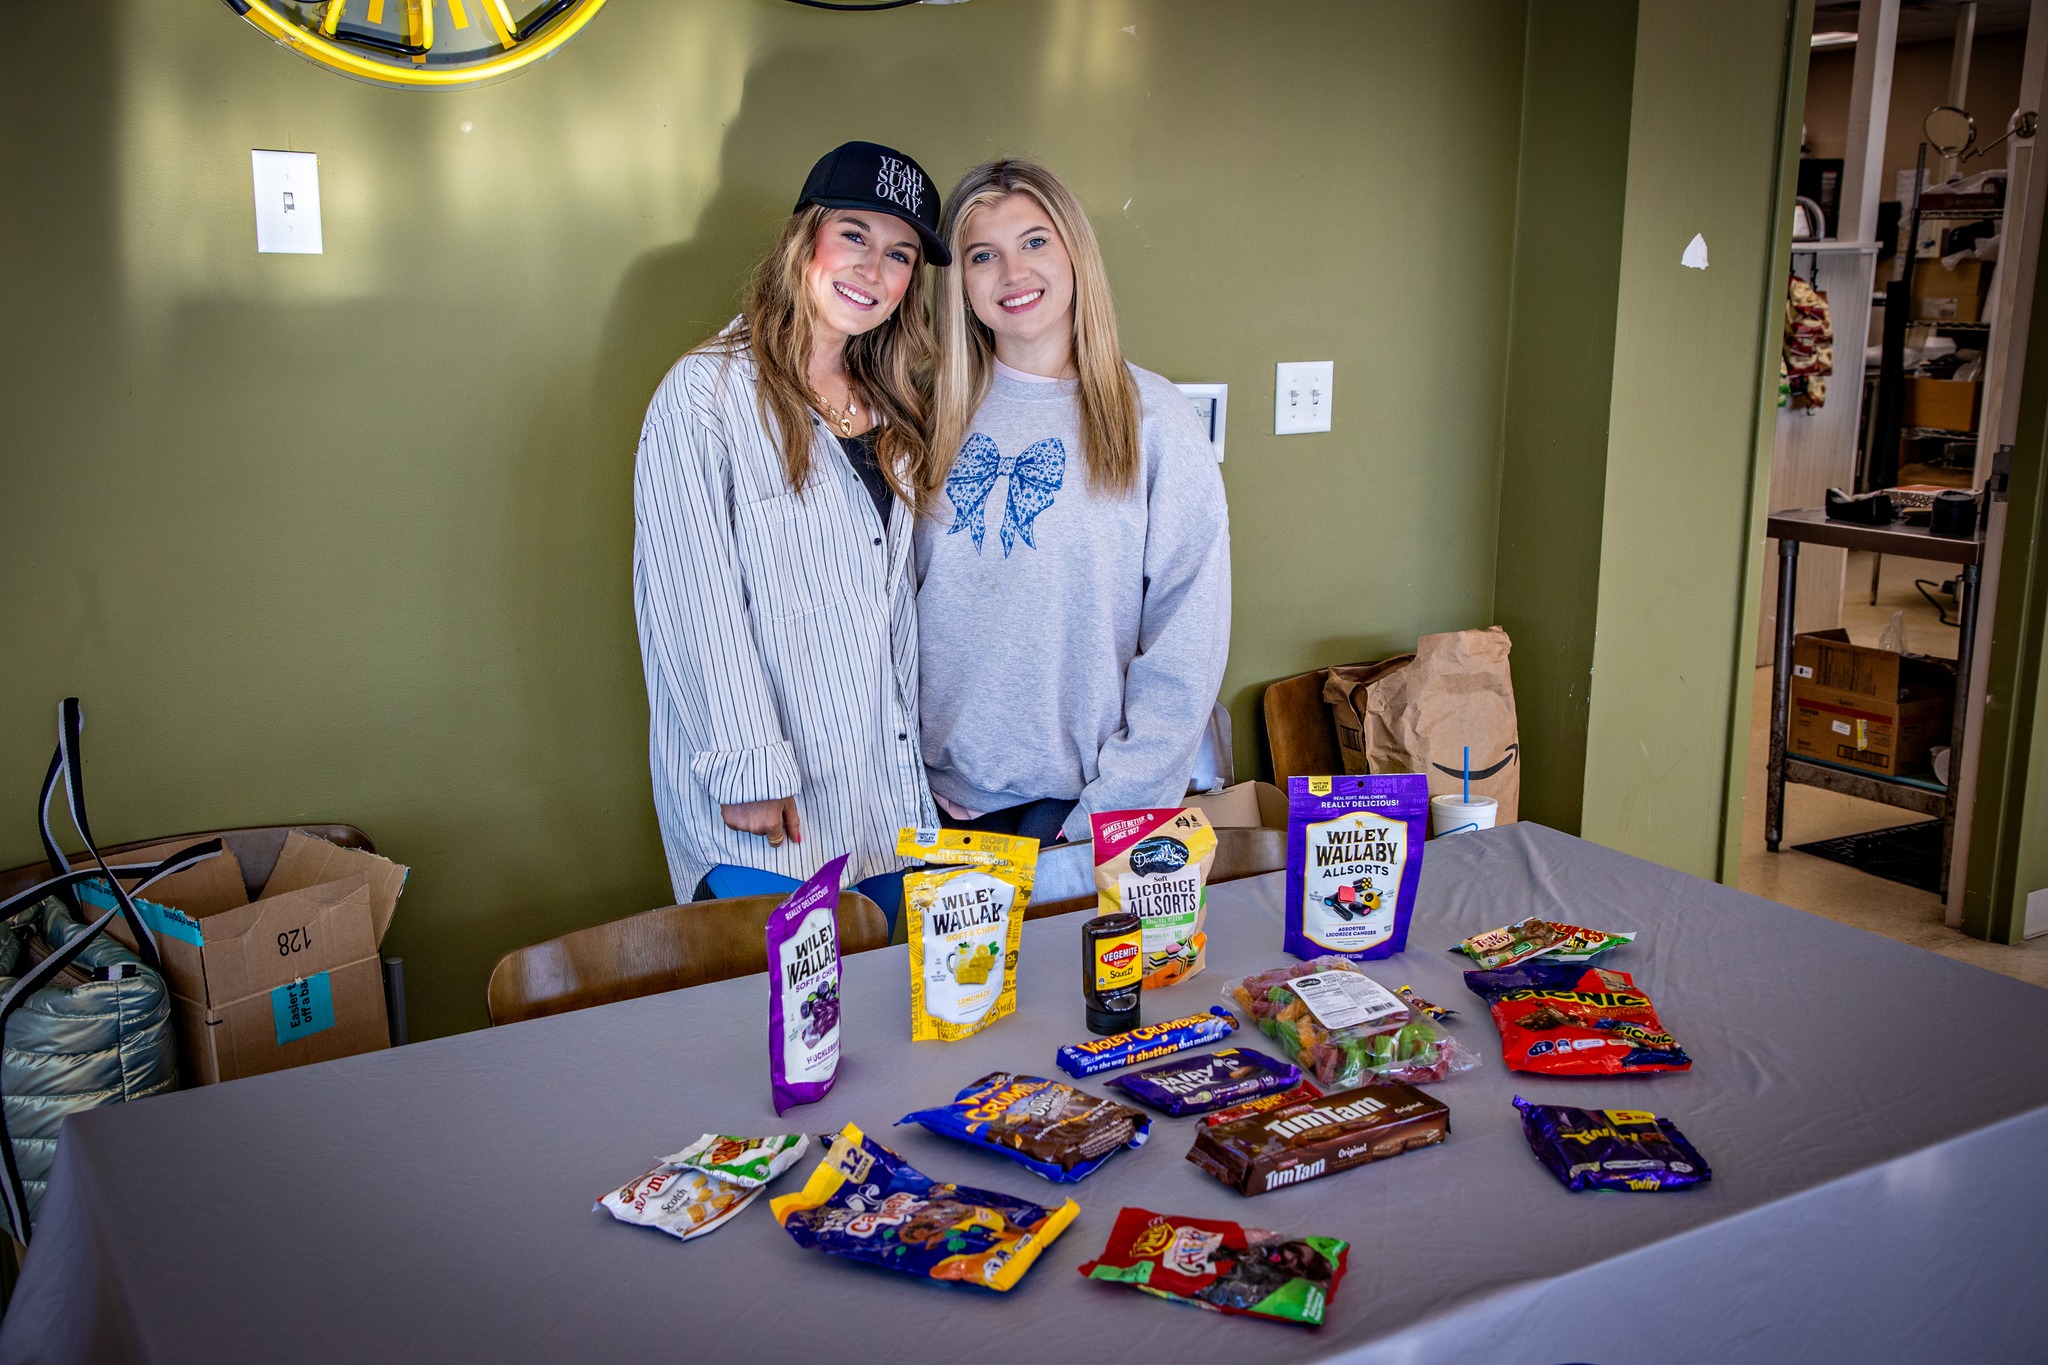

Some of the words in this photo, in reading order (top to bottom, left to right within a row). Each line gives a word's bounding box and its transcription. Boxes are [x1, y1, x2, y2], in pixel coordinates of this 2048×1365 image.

[875, 182, 921, 218] OKAY.
[1321, 800, 1350, 809] REALLY
[1352, 799, 1399, 808] DELICIOUS!
[1102, 822, 1121, 839] MAKES
[1121, 821, 1127, 829] IT
[1126, 816, 1146, 827] BETTER
[1110, 831, 1128, 844] SINCE
[1128, 827, 1140, 838] 1927
[1326, 828, 1389, 844] WILEY
[1316, 842, 1398, 867] WALLABY
[1322, 864, 1389, 878] ALLSORTS
[941, 887, 996, 911] WILEY
[1128, 879, 1196, 900] LICORICE
[784, 903, 802, 921] REALLY
[1130, 893, 1196, 918] ALLSORTS
[277, 926, 312, 957] 128
[795, 924, 835, 960] WILEY
[946, 931, 967, 942] SOFT
[976, 925, 999, 936] CHEWY
[1103, 946, 1138, 963] VEGEMITE
[795, 977, 815, 993] SOFT
[302, 997, 310, 1005] a
[957, 988, 991, 1006] LEMONADE
[288, 992, 302, 1029] Easier
[301, 1006, 313, 1024] off
[1077, 1033, 1133, 1055] VIOLET
[1613, 1026, 1674, 1044] PICNIC
[1086, 1063, 1099, 1074] It's
[1099, 1060, 1111, 1070] the
[1111, 1057, 1126, 1068] way
[1127, 1054, 1135, 1065] it
[1136, 1042, 1179, 1062] shatters
[1179, 1039, 1193, 1049] that
[1148, 1064, 1214, 1087] DAIRY
[1161, 1077, 1221, 1094] MILK
[1616, 1112, 1633, 1121] 5
[1338, 1143, 1368, 1159] Original
[839, 1147, 865, 1176] 12
[853, 1157, 870, 1180] PIECES
[660, 1187, 688, 1214] Scotch
